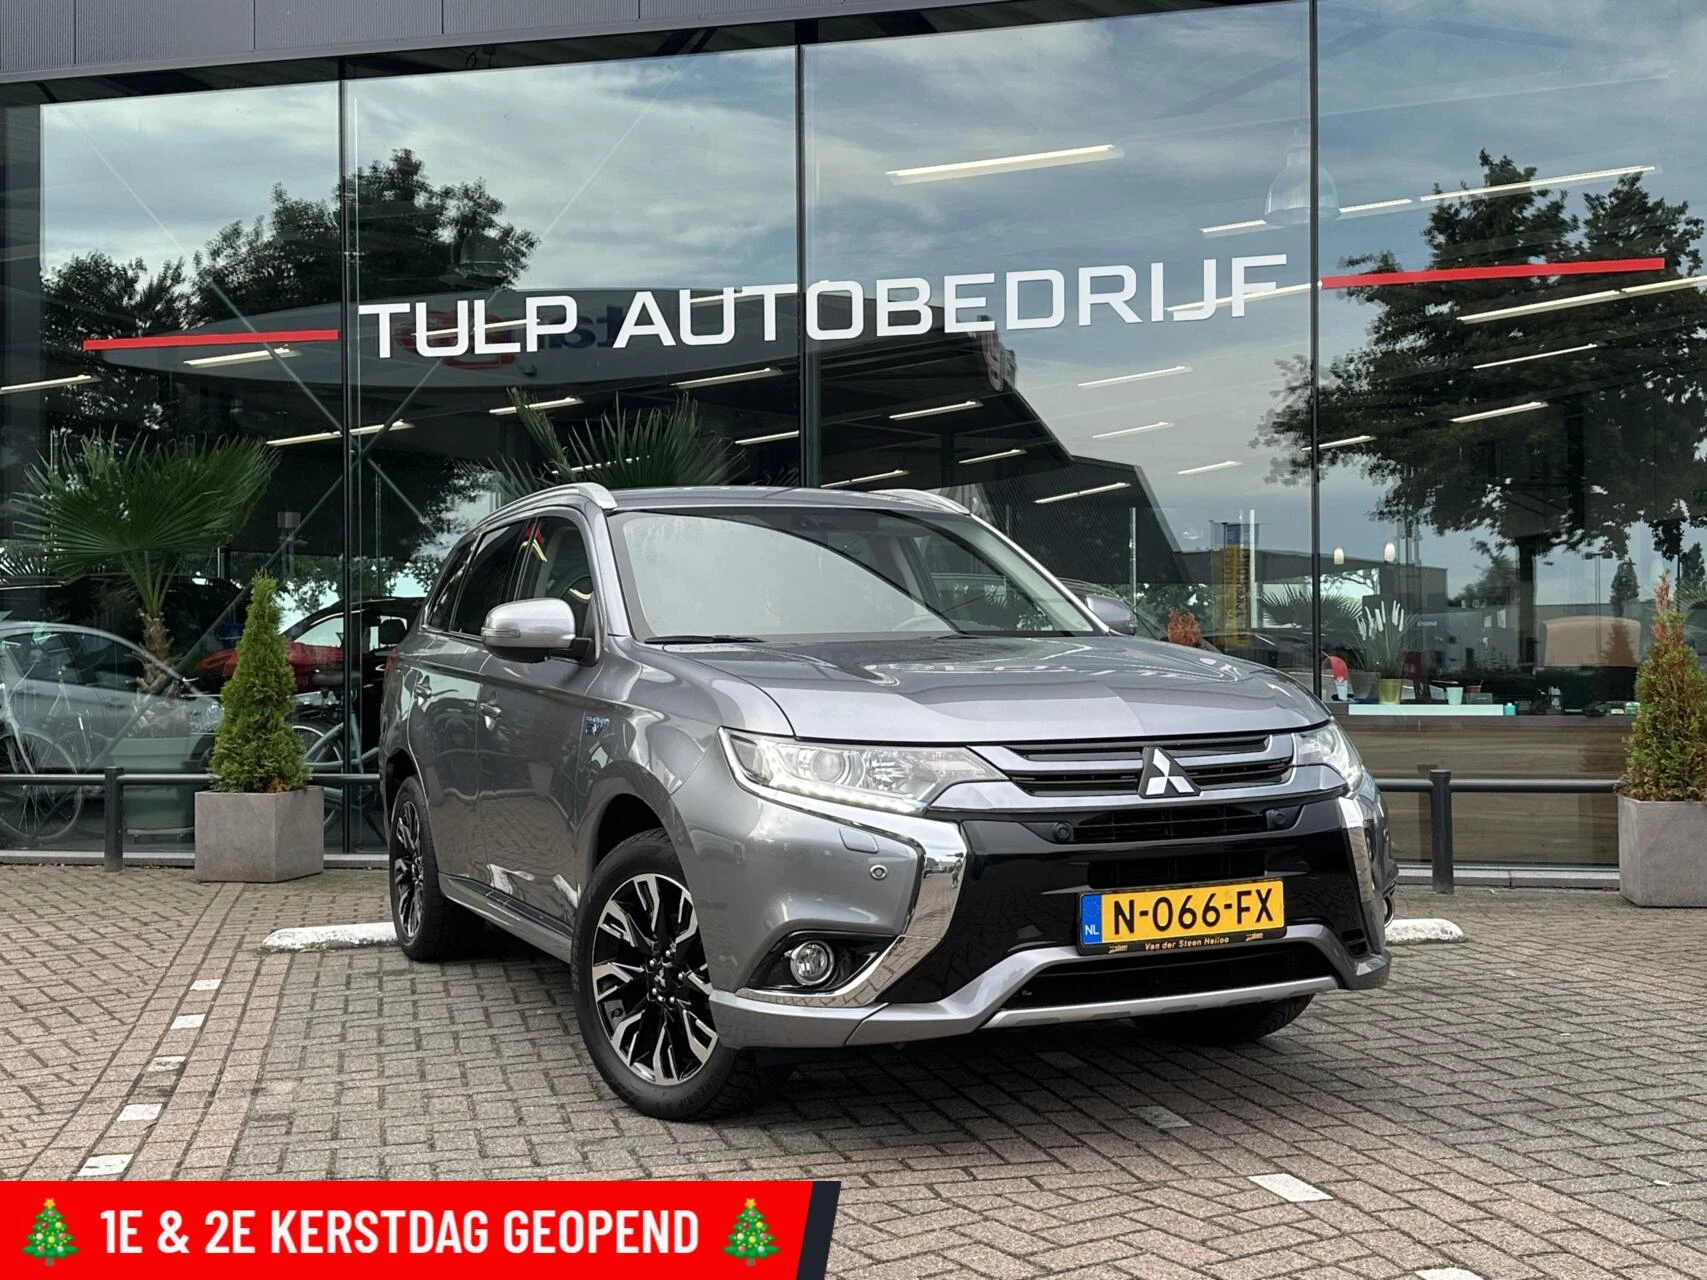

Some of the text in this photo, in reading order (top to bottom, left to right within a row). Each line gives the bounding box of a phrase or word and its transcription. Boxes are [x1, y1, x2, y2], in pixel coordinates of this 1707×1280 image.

[359, 296, 577, 358] TULP
[614, 254, 1288, 349] AUTOBEDRIJF
[1112, 888, 1274, 936] N-066-FX
[1084, 924, 1100, 936] NL
[1144, 942, 1160, 951] Van
[1161, 940, 1177, 949] der
[1178, 938, 1202, 948] Steen
